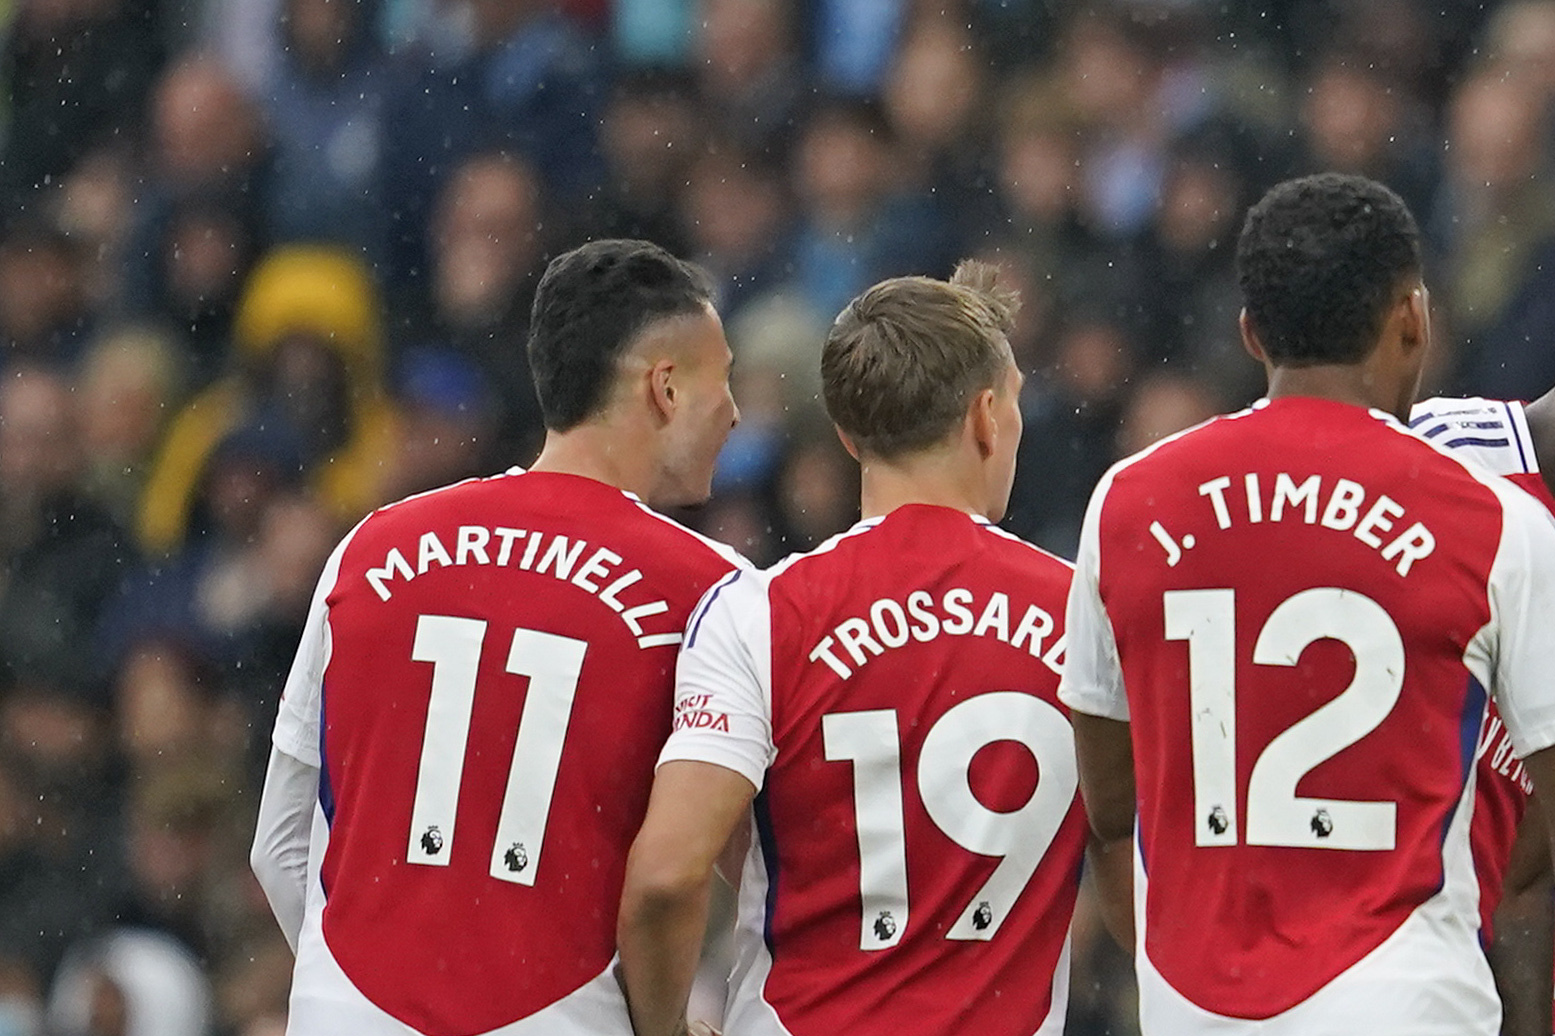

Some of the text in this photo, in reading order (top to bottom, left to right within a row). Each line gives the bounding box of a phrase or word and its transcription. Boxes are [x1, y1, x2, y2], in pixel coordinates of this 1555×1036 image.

[365, 526, 683, 649] MARTINELLI
[1149, 473, 1436, 577] J. TIMBER
[406, 615, 588, 886] 11
[823, 692, 1078, 951] 19
[1163, 587, 1405, 851] 12
